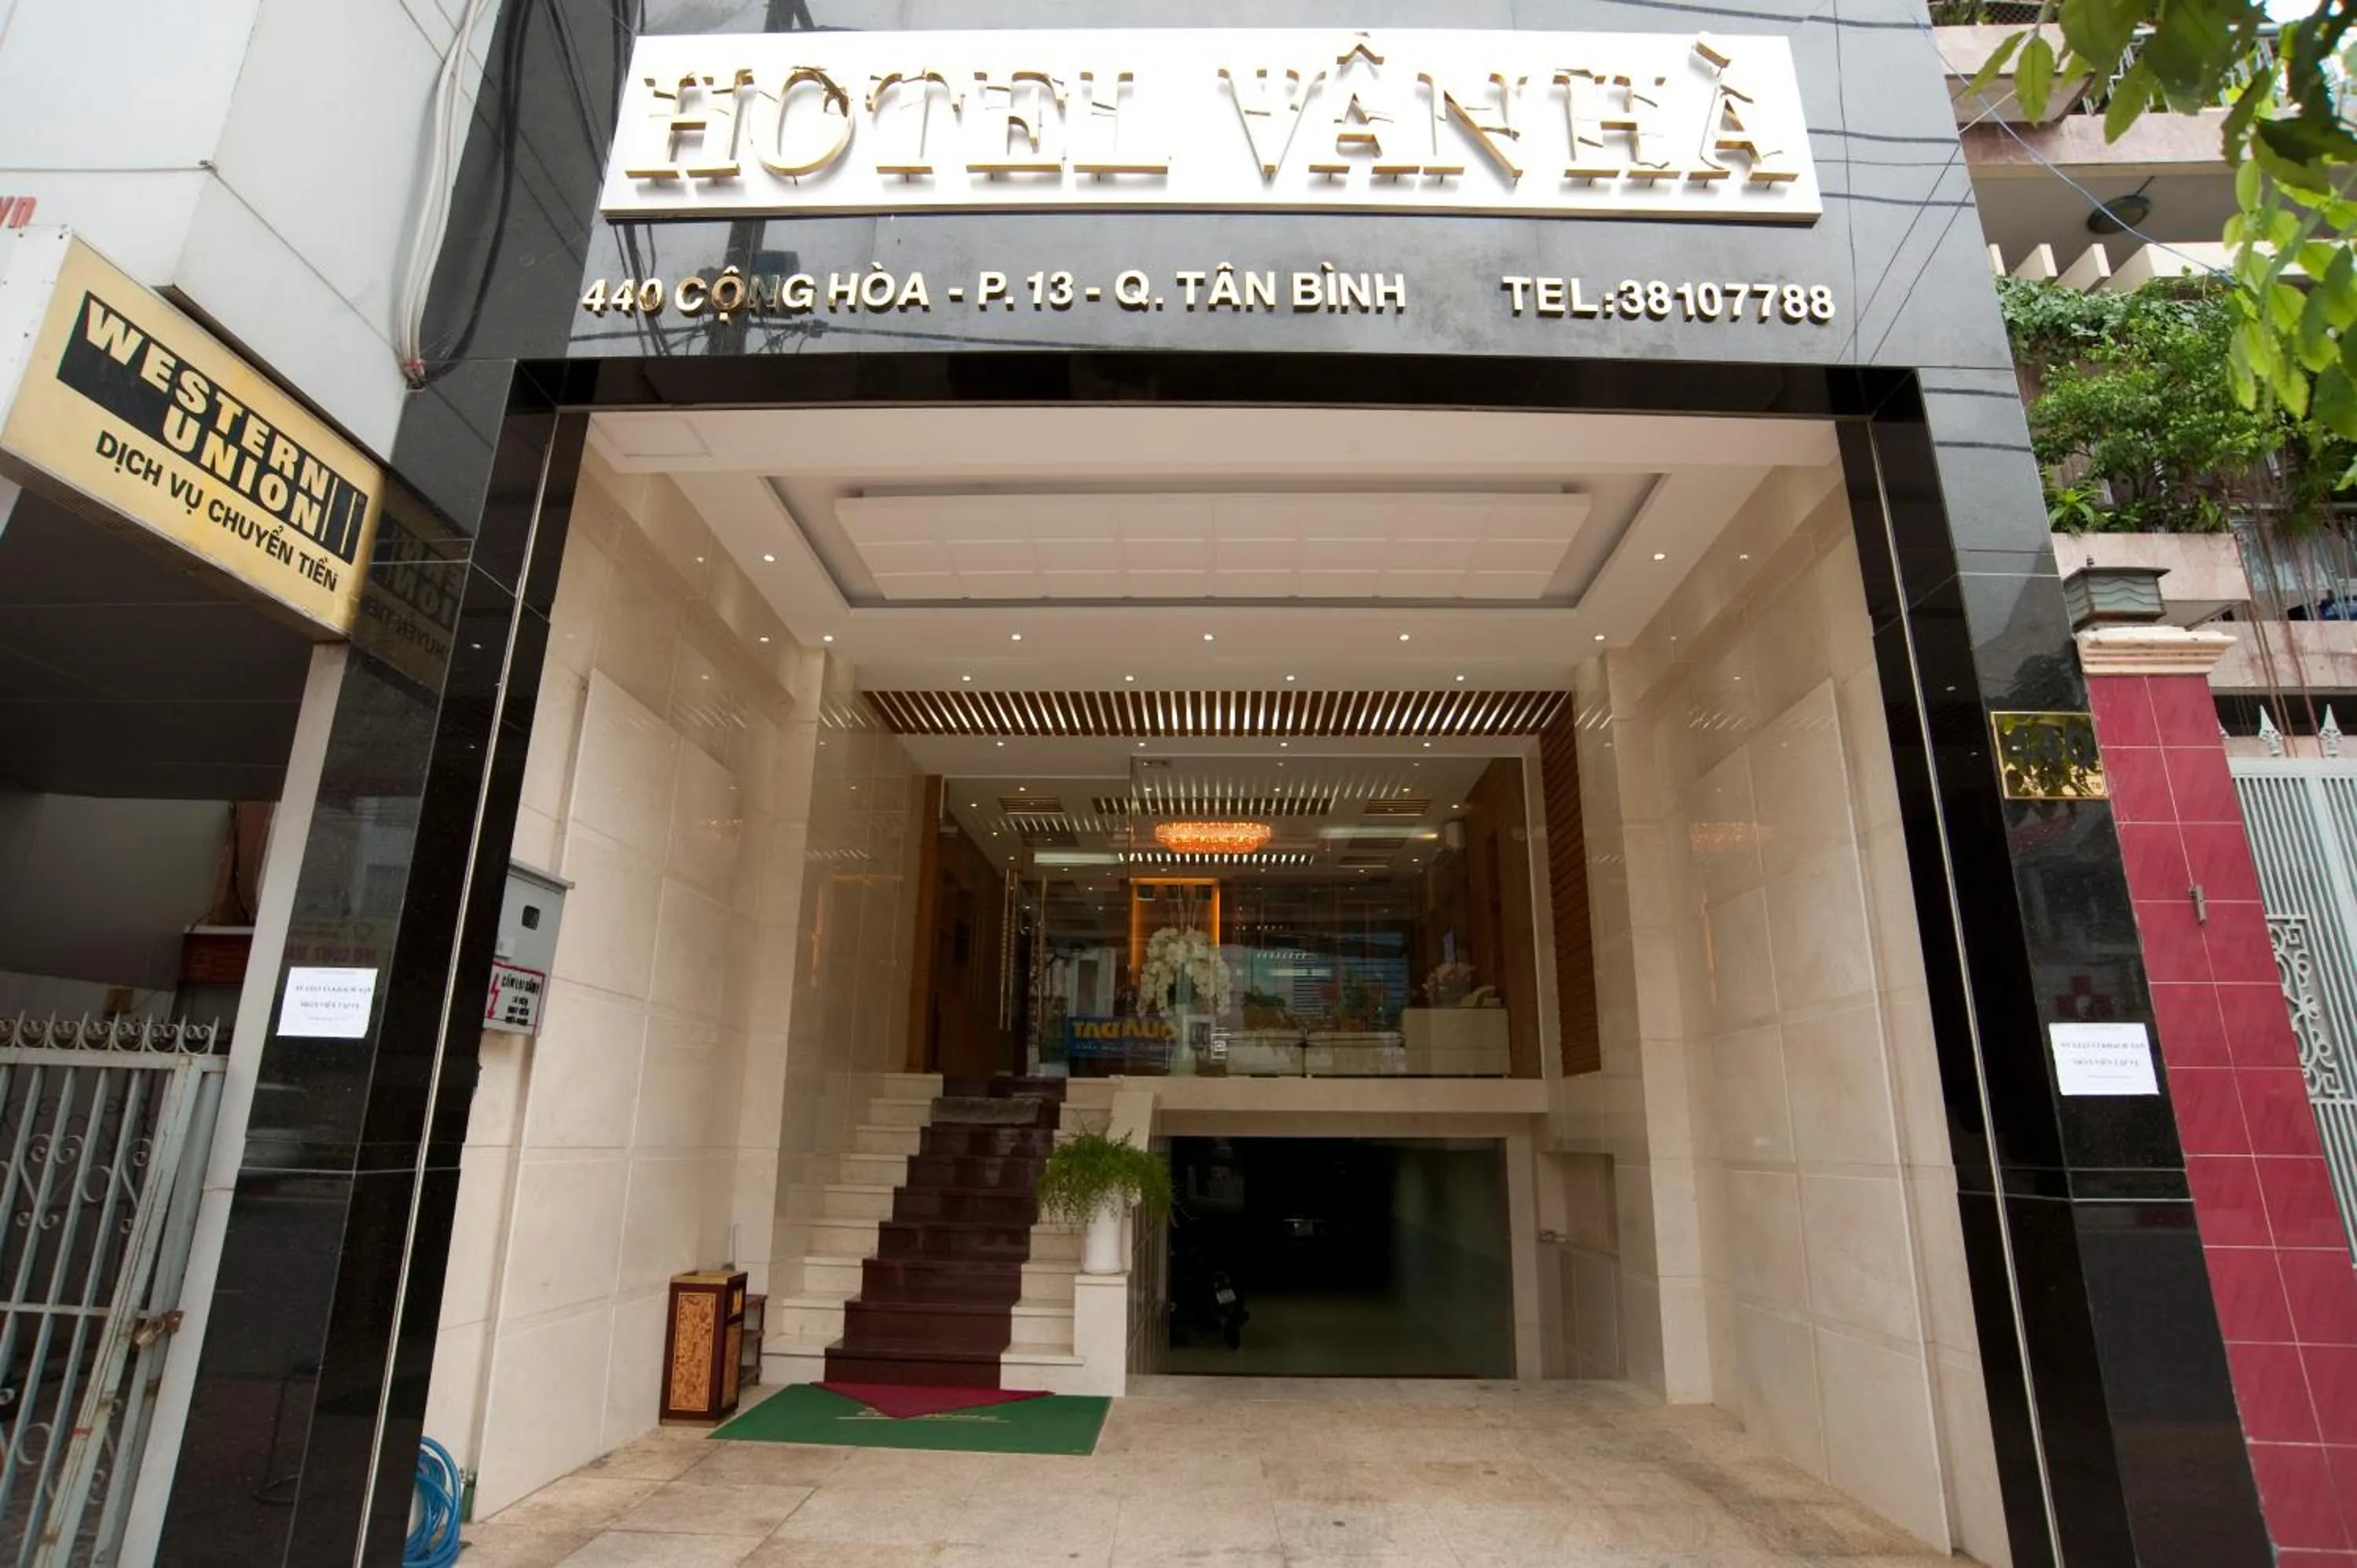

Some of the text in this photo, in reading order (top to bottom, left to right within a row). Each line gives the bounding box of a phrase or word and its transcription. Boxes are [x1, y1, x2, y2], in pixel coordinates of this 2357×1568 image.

[626, 64, 1169, 178] HOTEL
[582, 277, 664, 314] 440
[674, 265, 816, 324] CỘNG
[828, 262, 930, 312] HÒA
[1176, 262, 1276, 312] TÂN
[1293, 262, 1406, 313] BÌNH
[1501, 276, 1836, 324] TEL:38107788
[86, 299, 329, 500] WESTERN
[96, 430, 163, 487] DỊCH
[171, 471, 203, 515] VỤ
[208, 498, 294, 566] CHUYỂN
[163, 404, 321, 537] UNION
